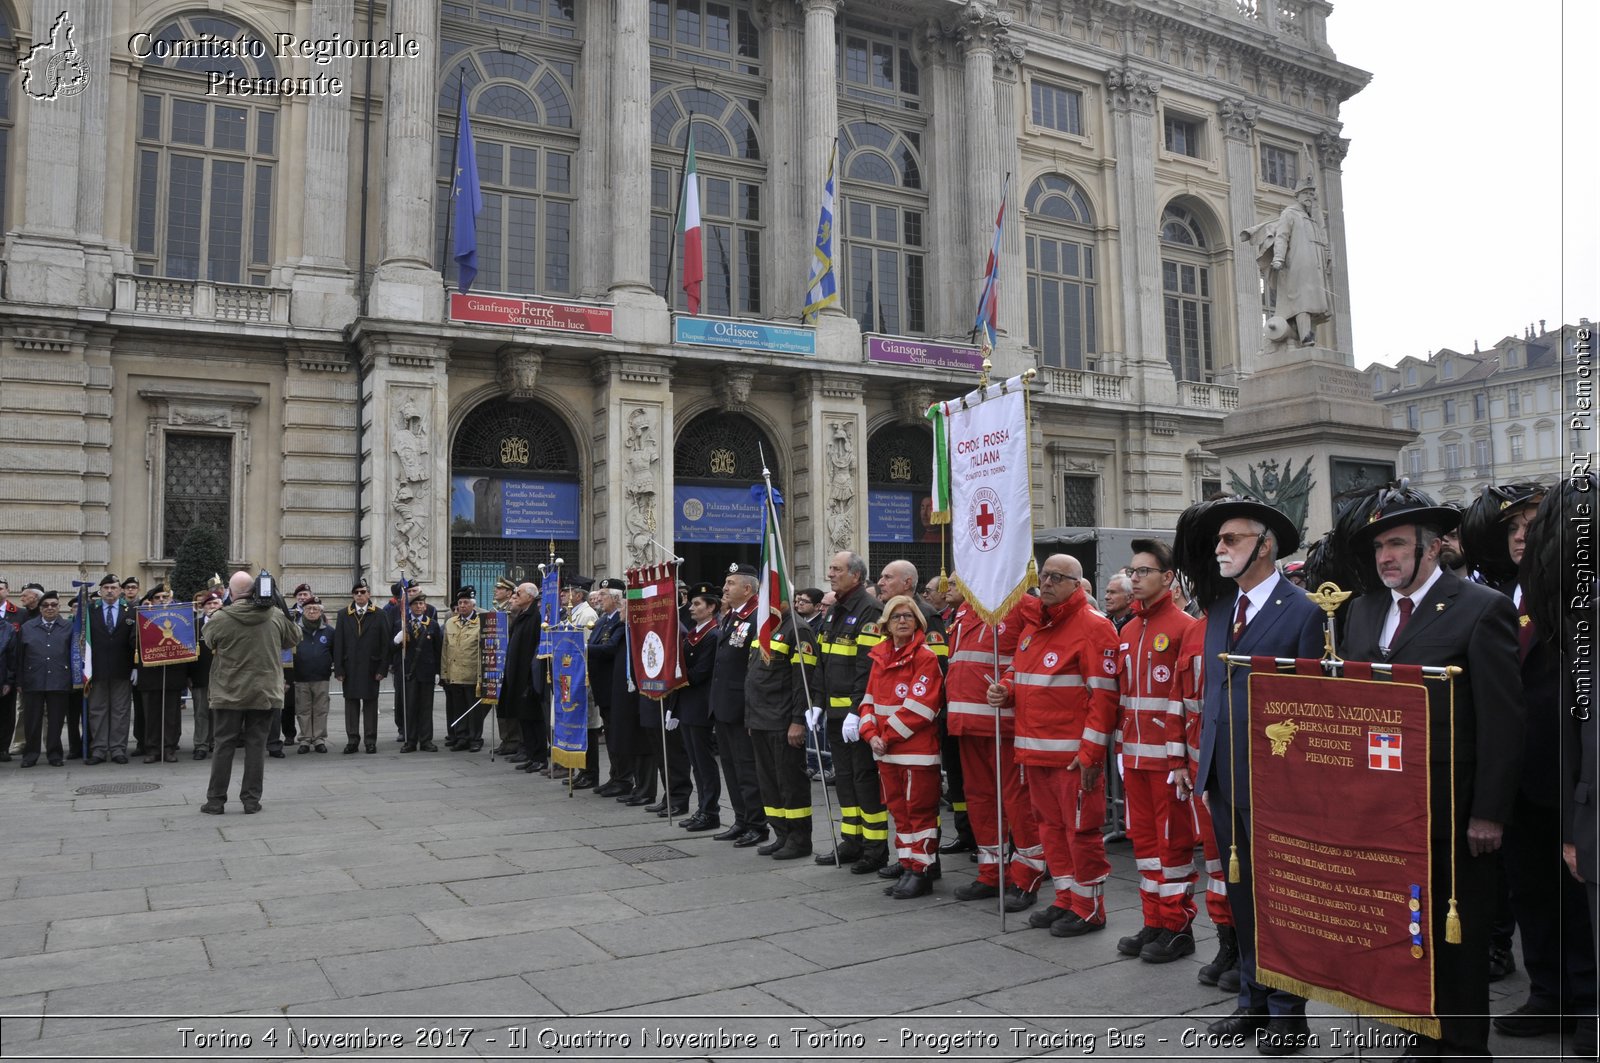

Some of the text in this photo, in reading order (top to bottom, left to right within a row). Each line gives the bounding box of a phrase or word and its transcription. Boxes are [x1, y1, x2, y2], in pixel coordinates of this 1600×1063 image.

[467, 300, 520, 315] Gianfranco
[521, 302, 554, 318] Ferré
[508, 313, 531, 325] Sotto
[567, 319, 585, 330] luce
[714, 322, 759, 339] Odissee
[881, 340, 927, 356] Giansone
[909, 355, 975, 369] Sculture da indossare
[983, 429, 1010, 447] ROSSA
[528, 491, 557, 499] Medievale
[521, 508, 554, 516] Panoramica
[706, 502, 760, 512] Palazzo Madama
[545, 518, 575, 527] Principessa
[145, 645, 171, 654] CARRISTI
[1263, 701, 1402, 725] ASSOCIAZIONE NAZIONALE
[1299, 721, 1362, 736] BERSAGLIERI
[1368, 725, 1402, 734] PIEMONTE
[1308, 736, 1352, 751] REGIONE
[1305, 752, 1354, 767] PIEMONTE
[1342, 849, 1353, 857] AD
[1281, 853, 1301, 865] ORDINI
[1301, 858, 1327, 871] MILITARI
[1282, 871, 1313, 886] MEDAGLIE
[1334, 884, 1344, 893] AL
[1345, 885, 1371, 897] VALOR
[1372, 889, 1405, 904] MILITARE
[1286, 888, 1318, 904] MEDAGLIE
[1358, 904, 1369, 914] AL
[1288, 905, 1321, 921] MEDAGLIE
[1330, 916, 1360, 929] BRONZO
[1362, 922, 1373, 931] AL
[1287, 921, 1307, 933] CROCI
[1316, 929, 1344, 943] GUERRA
[1345, 935, 1356, 944] AL
